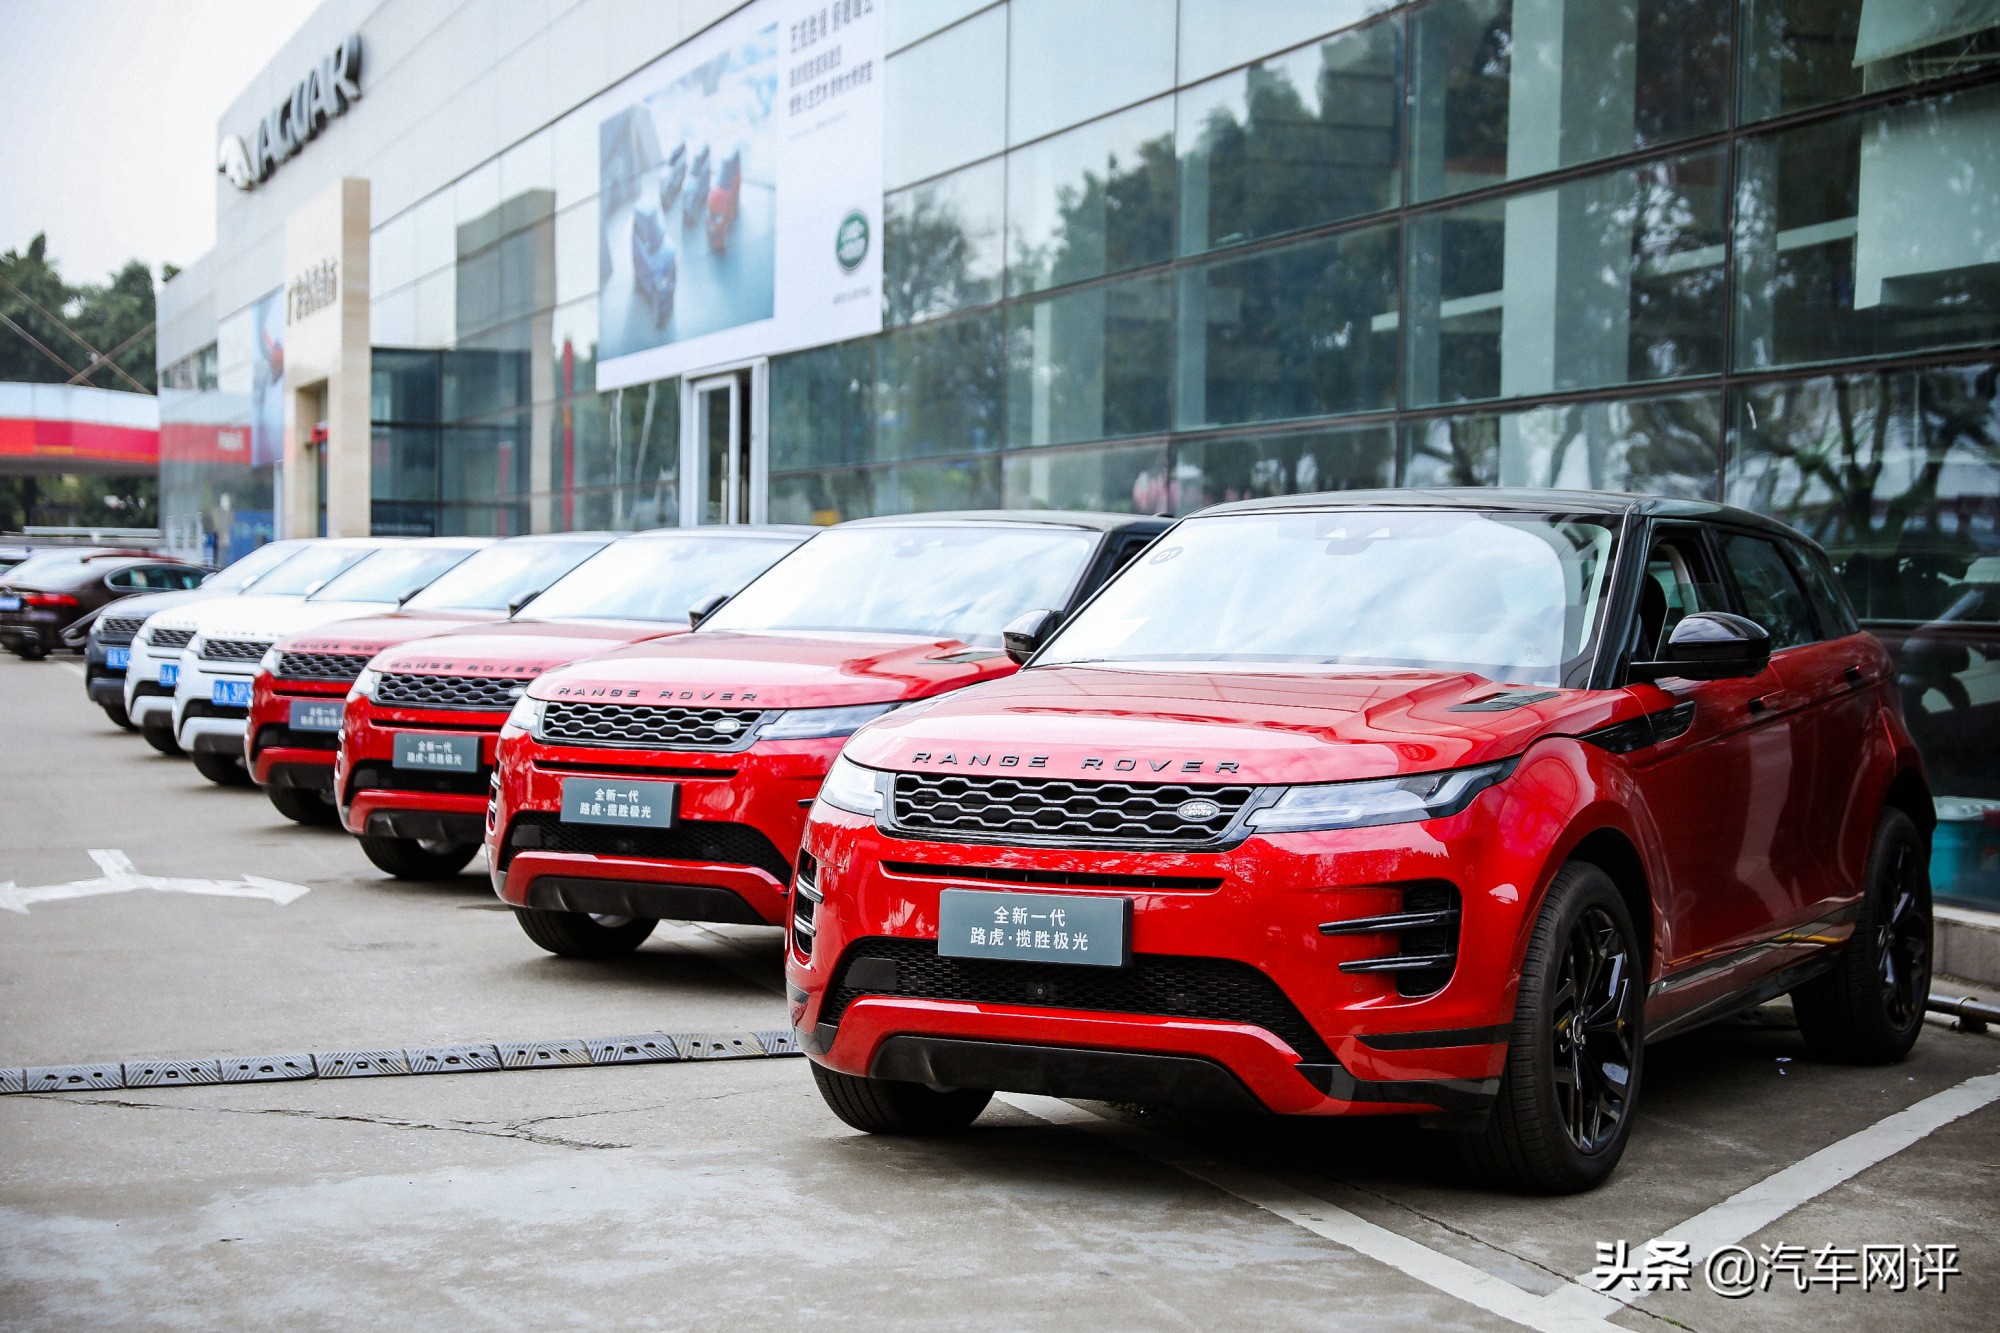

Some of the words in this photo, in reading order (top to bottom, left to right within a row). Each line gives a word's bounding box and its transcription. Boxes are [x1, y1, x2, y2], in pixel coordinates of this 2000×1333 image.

[467, 664, 543, 673] ROVER
[558, 687, 640, 698] RANGE
[658, 690, 757, 702] ROVER
[912, 752, 1049, 768] RANGE
[1080, 756, 1241, 773] ROVER
[594, 788, 639, 803] 全新一代
[993, 905, 1067, 928] 全新一代
[970, 926, 1089, 951] 路虎·揽胜极光
